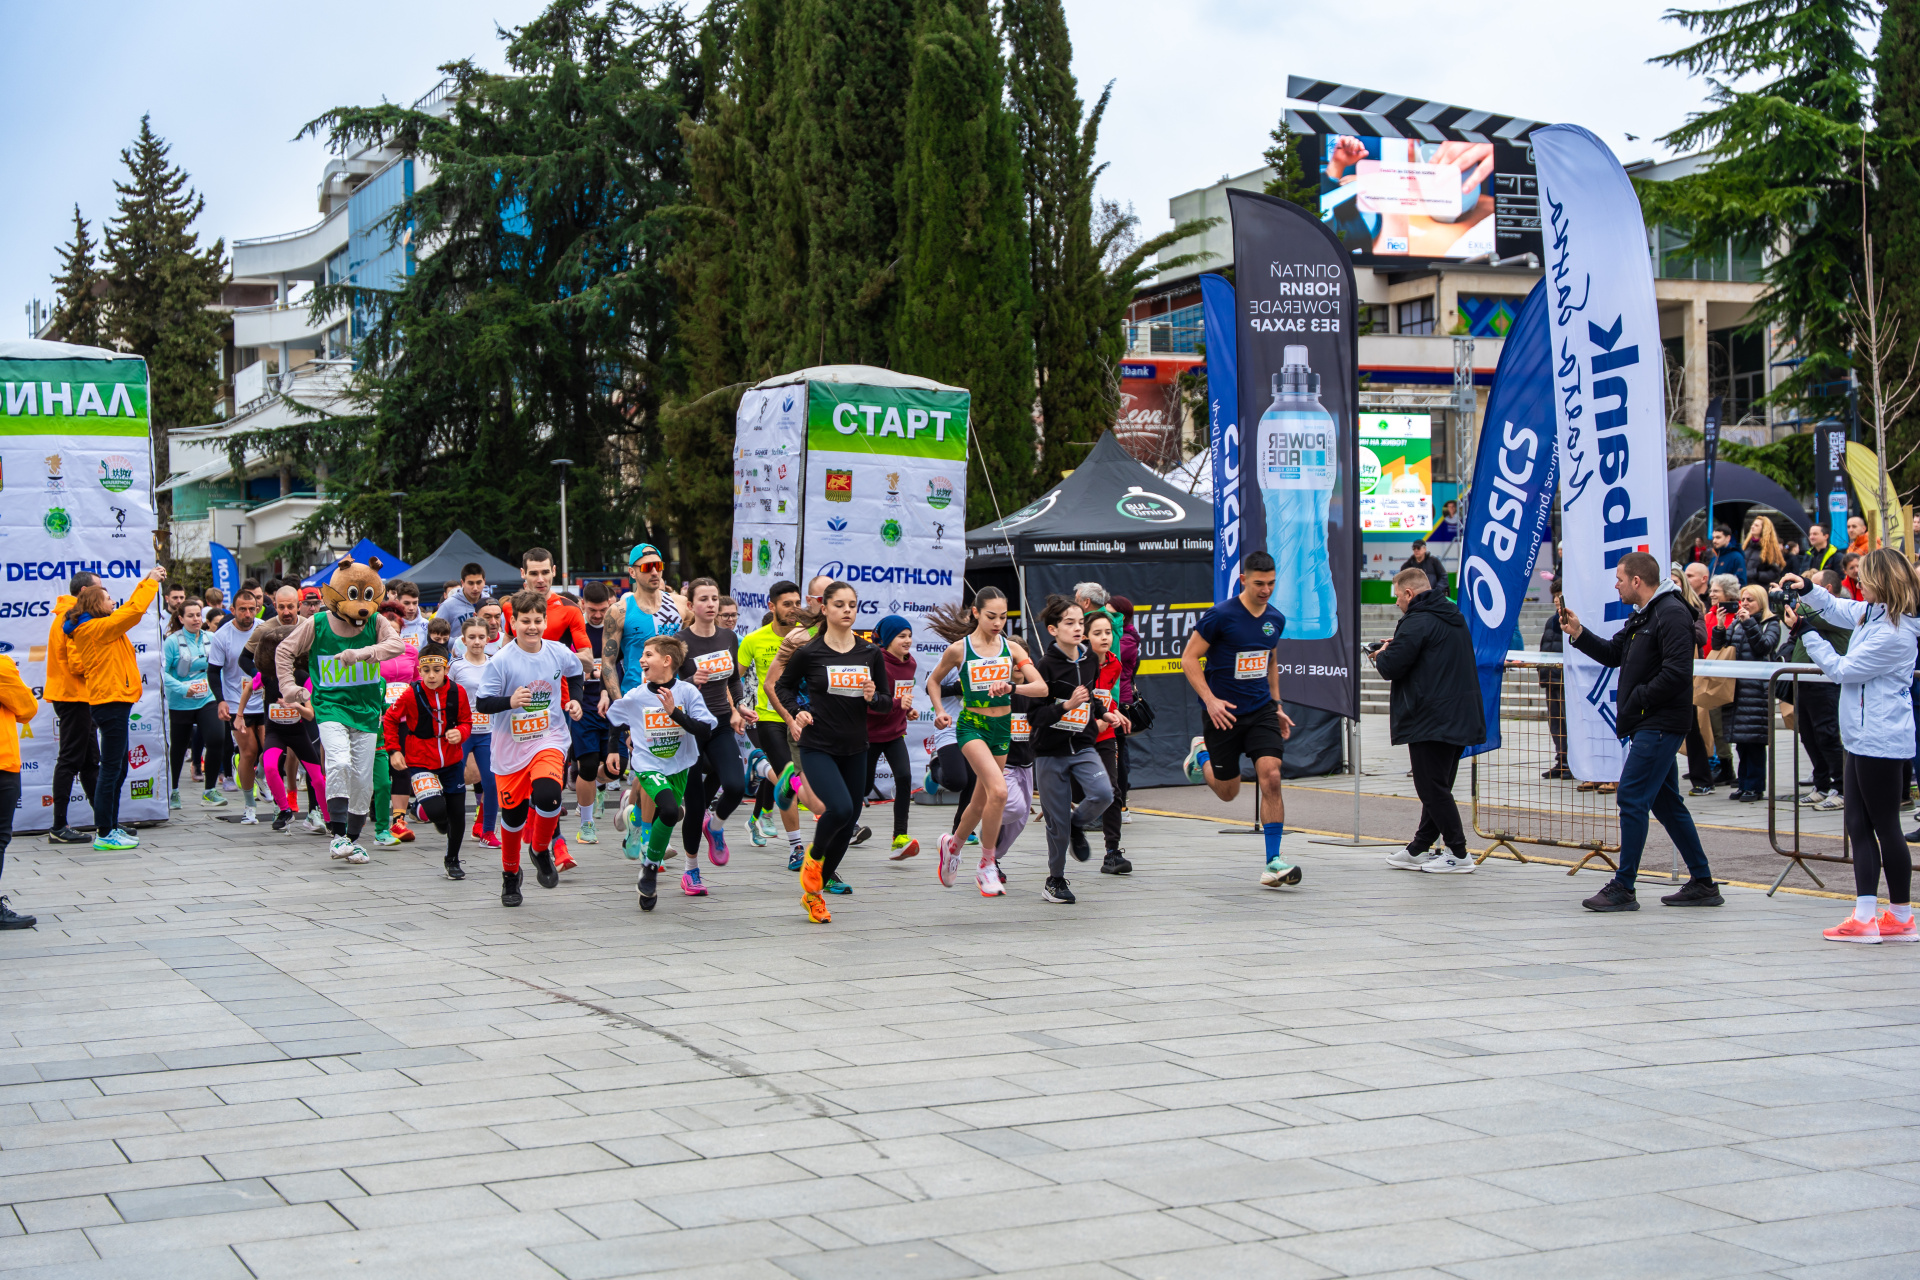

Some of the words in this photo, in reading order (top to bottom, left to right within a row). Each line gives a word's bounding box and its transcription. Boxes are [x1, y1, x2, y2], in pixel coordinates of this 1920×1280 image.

[0, 381, 136, 417] ИНАЛ
[832, 402, 951, 442] СТАРТ
[1829, 431, 1840, 471] POWER
[1481, 420, 1539, 562] asics
[1125, 502, 1151, 511] BUL
[1130, 509, 1174, 517] Timing
[1524, 531, 1542, 578] sound
[1535, 492, 1551, 531] mind,
[1034, 541, 1076, 553] www.bul
[1079, 539, 1126, 553] timing.bg
[1138, 538, 1179, 551] www.bul
[1182, 537, 1214, 551] timing
[6, 559, 141, 582] DECATHLON
[847, 564, 953, 586] DECATHLON
[0, 601, 50, 618] asics
[857, 600, 879, 614] ICS
[903, 601, 940, 612] Fibank
[916, 643, 948, 653] БАНКЯ
[1137, 640, 1182, 657] ULG
[1167, 661, 1182, 670] TOU
[1239, 658, 1266, 670] 1415
[321, 659, 380, 684] КИПИ
[973, 665, 1009, 681] 1472
[833, 674, 867, 687] 1612
[272, 709, 299, 718] 1532
[472, 714, 489, 723] 553
[920, 711, 934, 721] life
[1063, 710, 1087, 723] 444
[129, 722, 152, 731] e.bg
[514, 717, 548, 733] 1413
[1012, 721, 1031, 732] 151
[22, 762, 39, 770] INS
